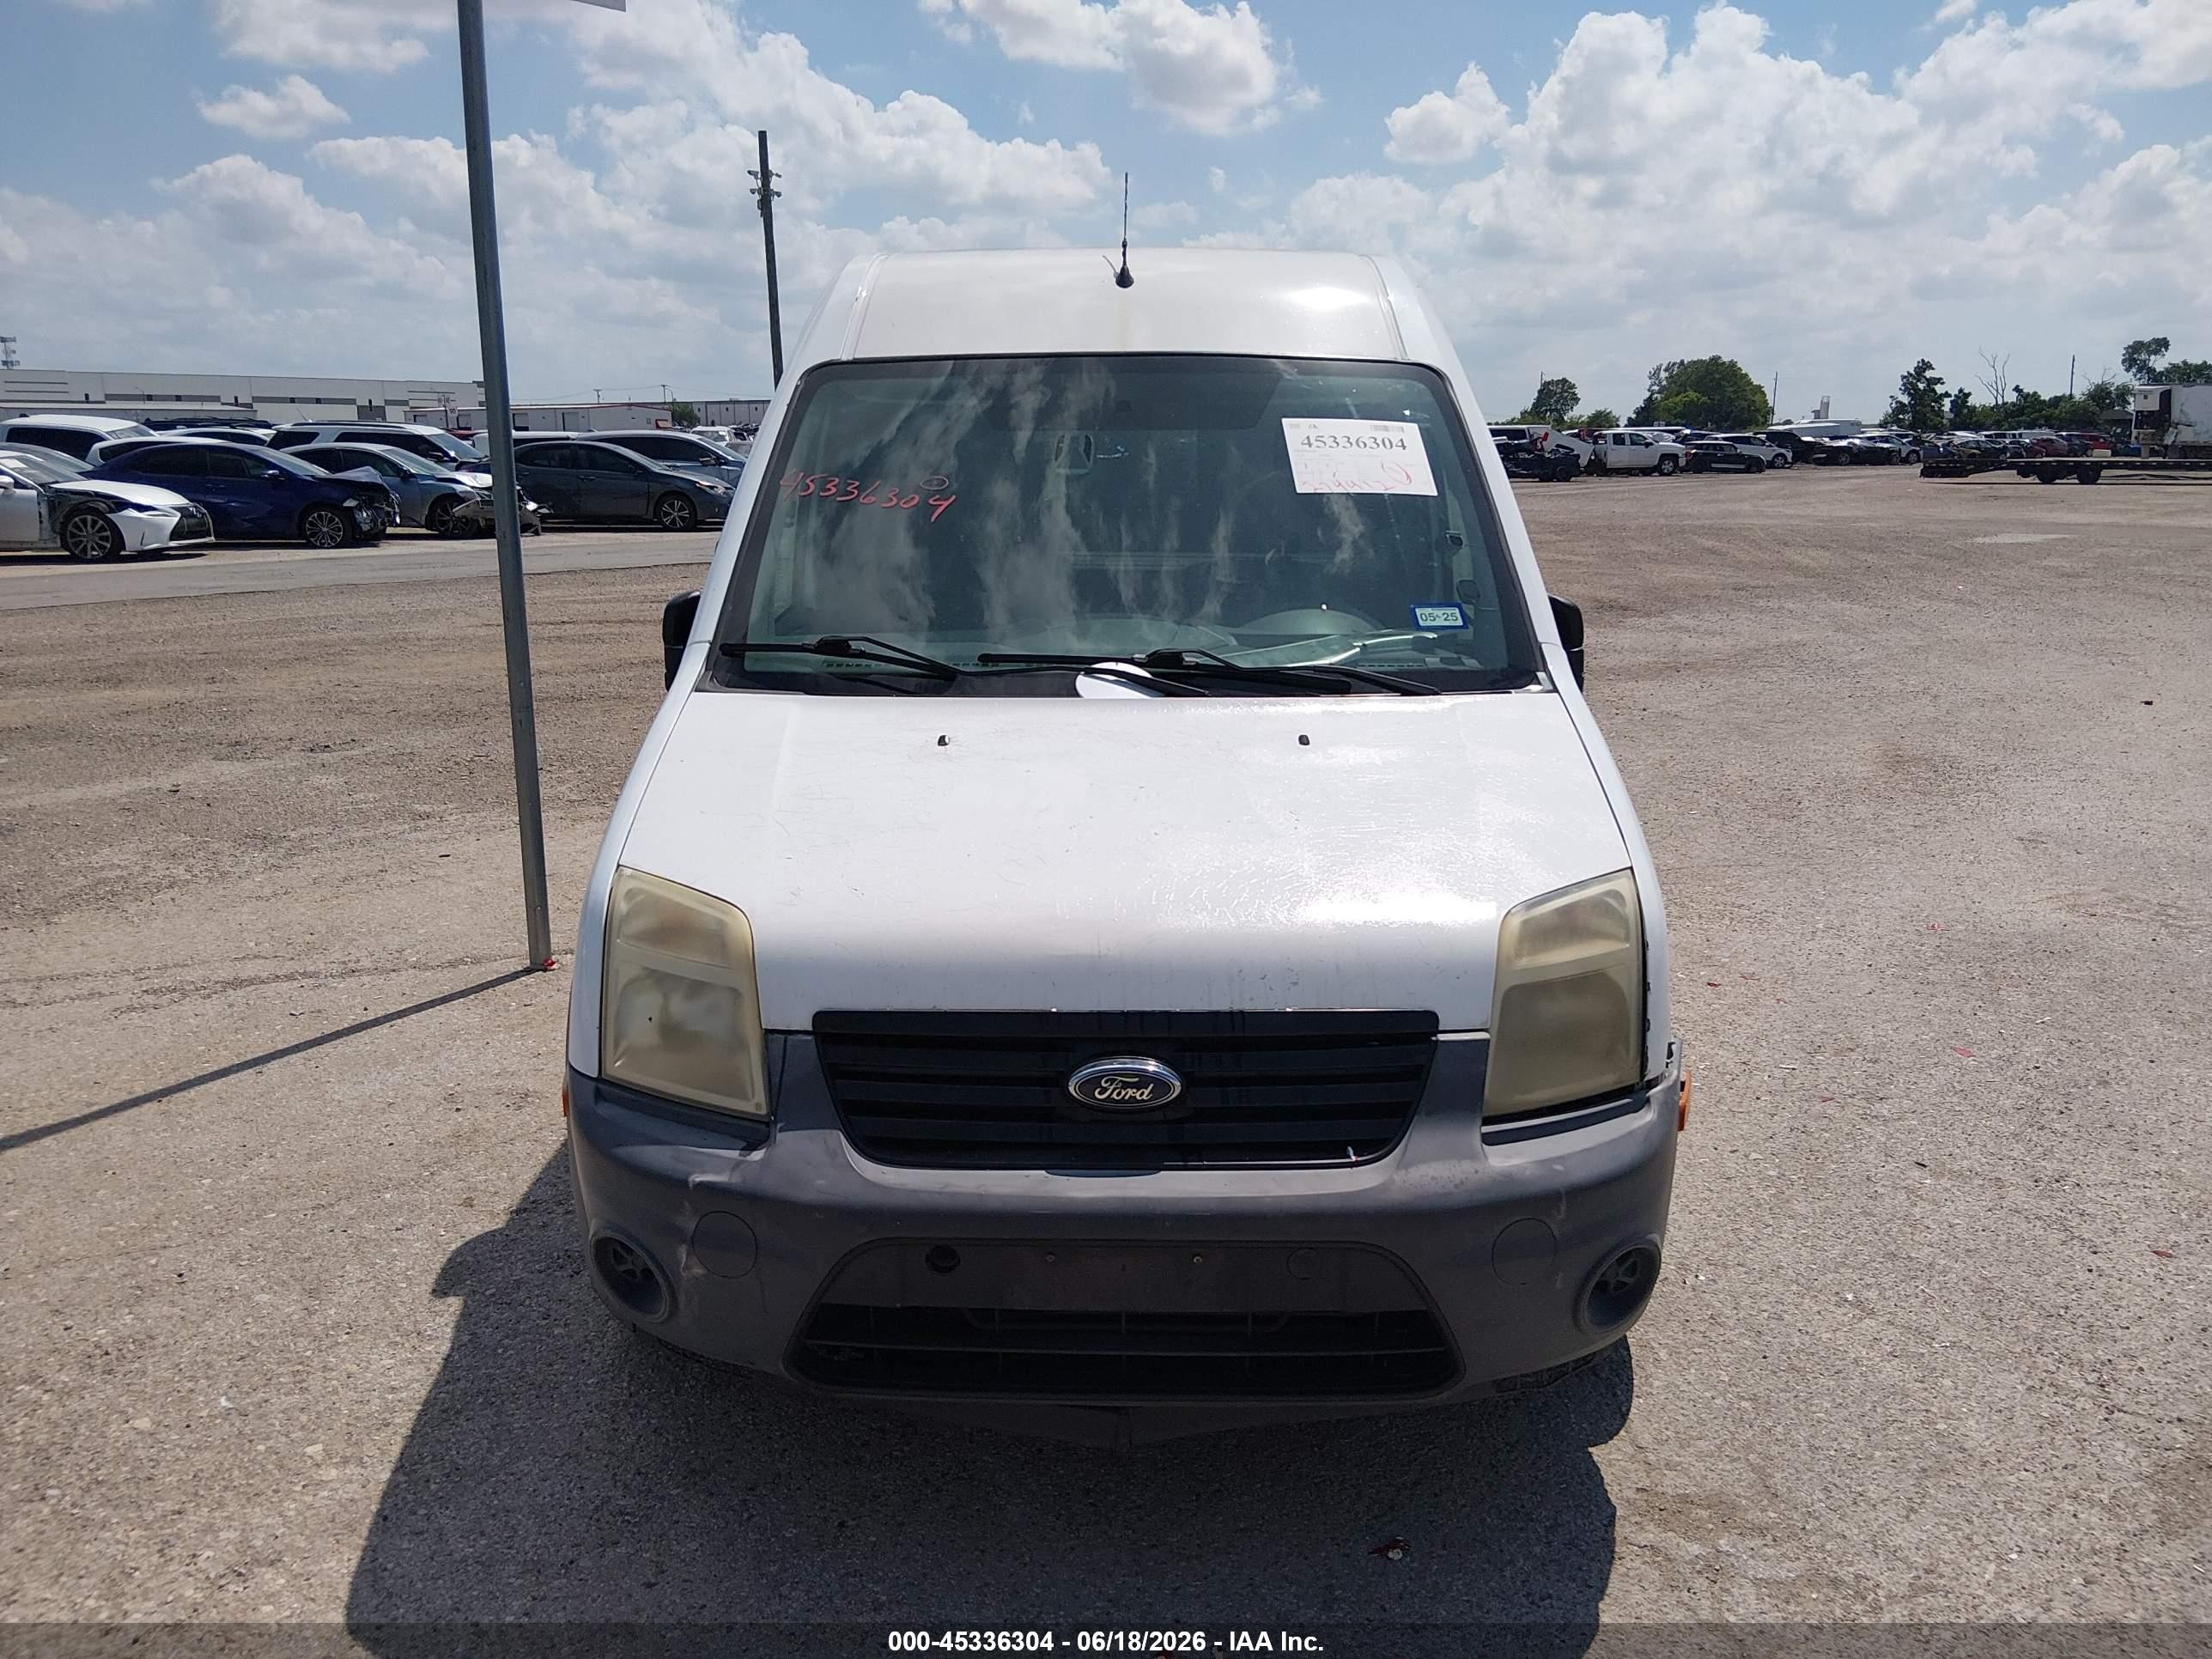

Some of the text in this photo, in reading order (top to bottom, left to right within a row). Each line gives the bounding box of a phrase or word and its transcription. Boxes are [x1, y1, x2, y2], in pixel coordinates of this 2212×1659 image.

[1300, 434, 1407, 451] 45336304
[779, 470, 956, 523] 45336304
[1094, 1076, 1154, 1100] Ford
